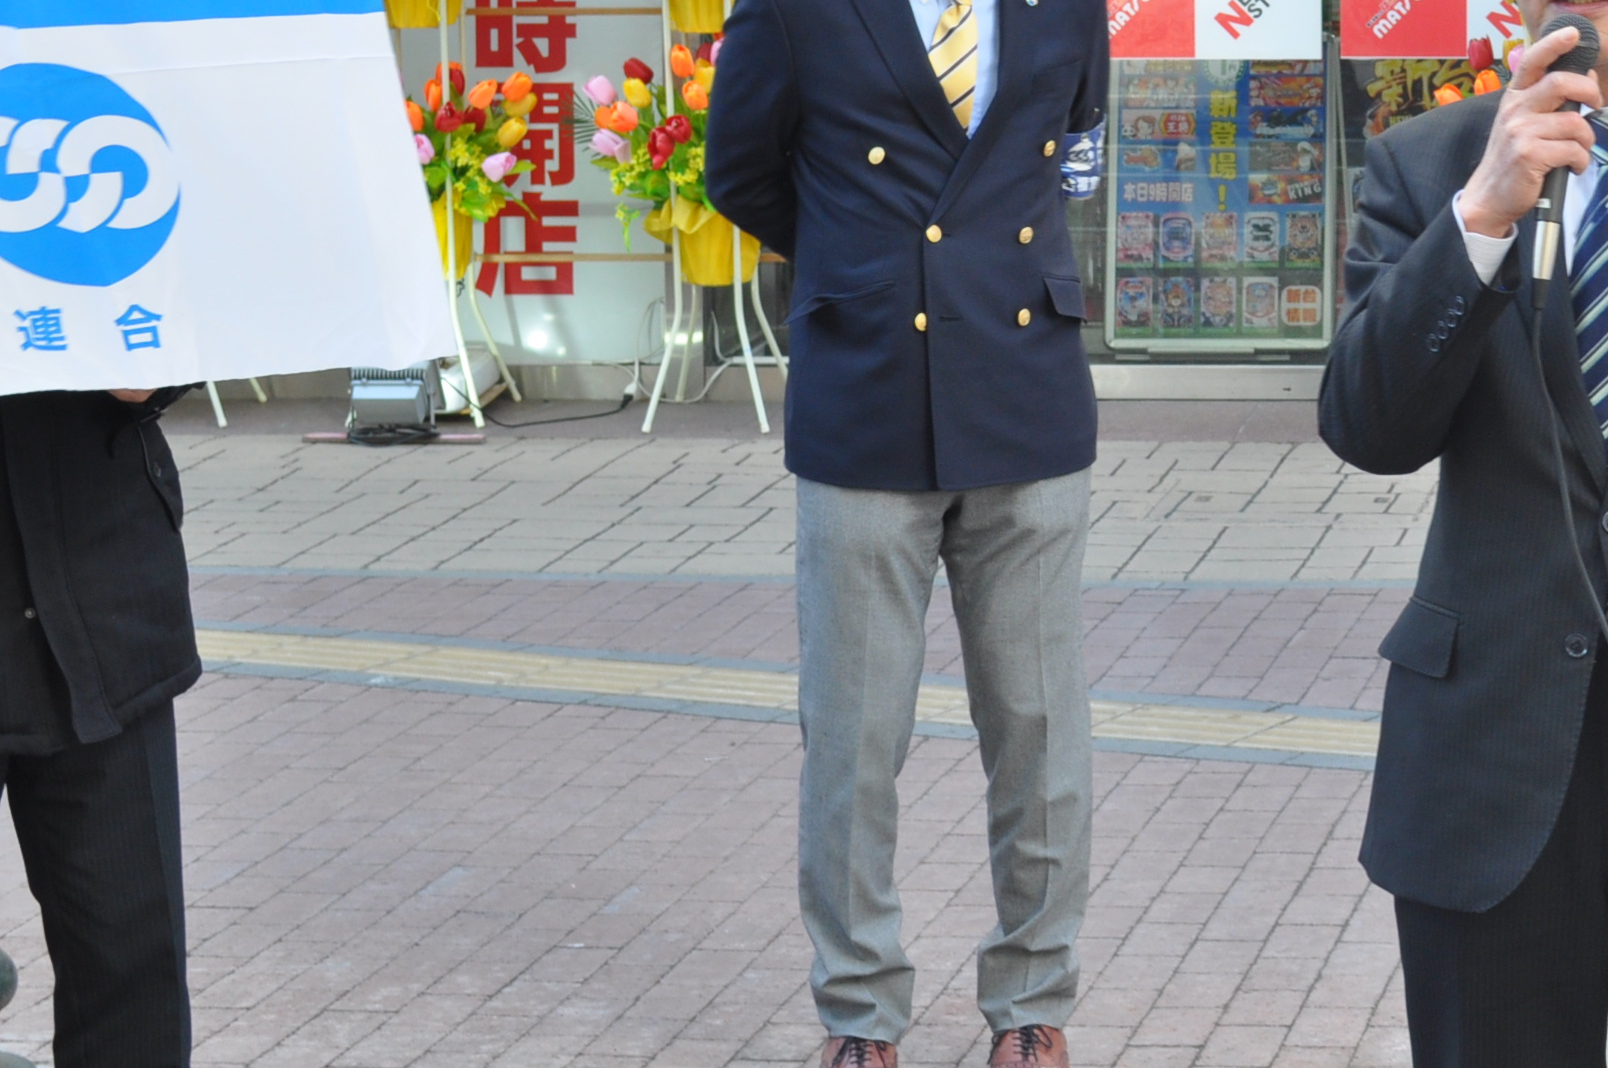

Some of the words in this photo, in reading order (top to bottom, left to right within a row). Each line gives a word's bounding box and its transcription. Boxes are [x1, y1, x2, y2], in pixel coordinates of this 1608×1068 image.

[1122, 181, 1195, 204] 本日9時開店
[13, 303, 164, 352] 連合
